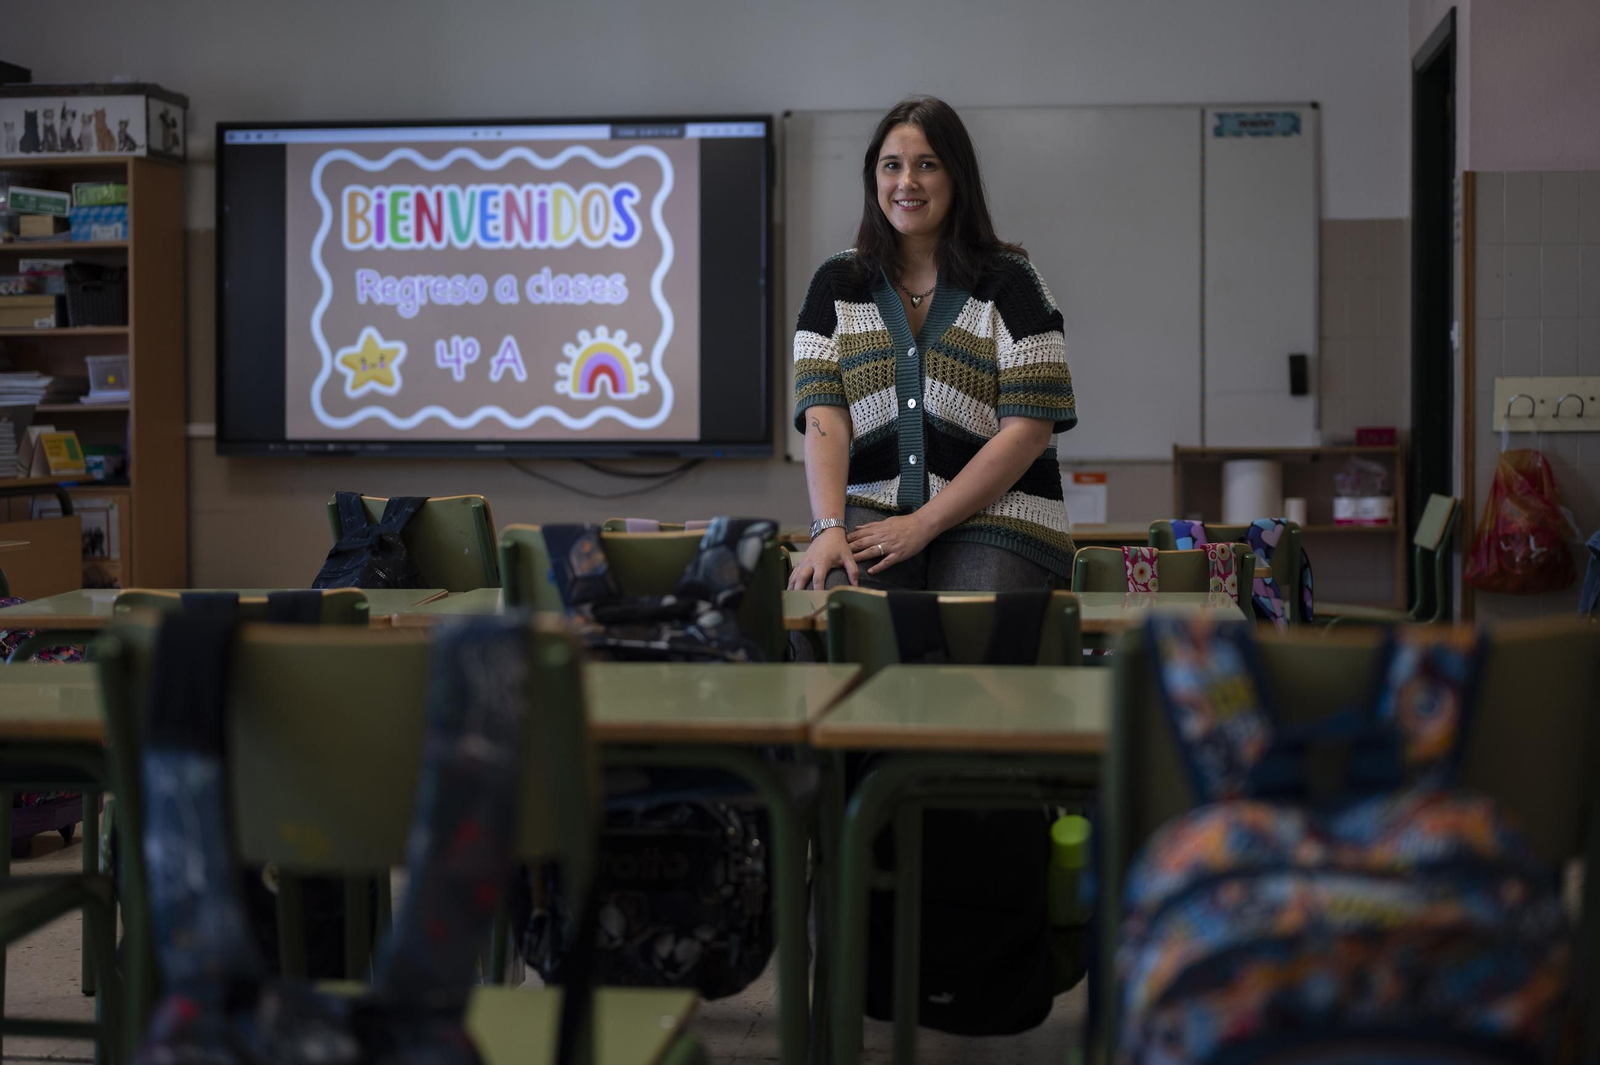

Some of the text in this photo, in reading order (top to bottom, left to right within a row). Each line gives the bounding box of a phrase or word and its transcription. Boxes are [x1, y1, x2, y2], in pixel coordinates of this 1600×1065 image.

[355, 265, 629, 318] Regreso a clases
[490, 335, 527, 382] A
